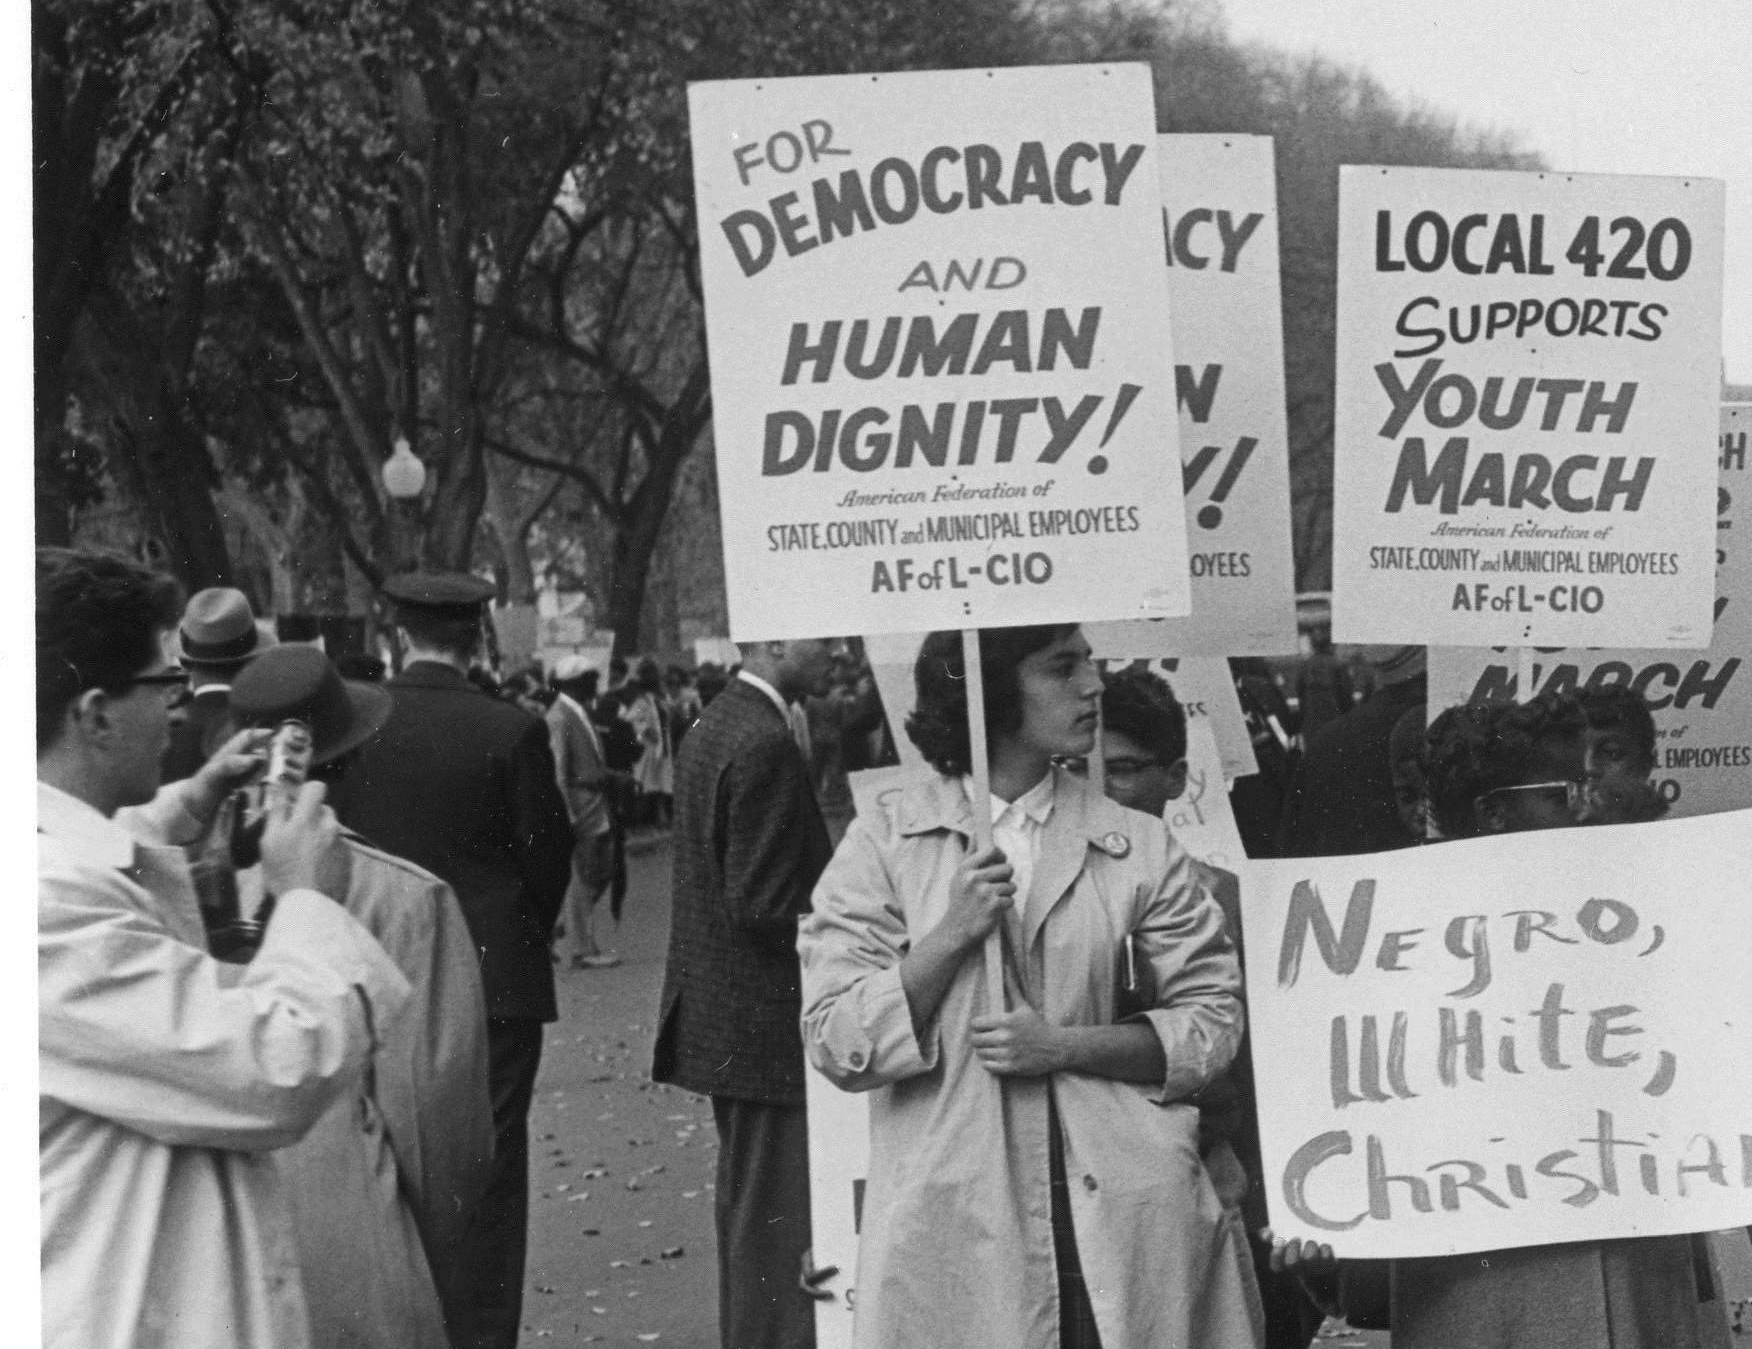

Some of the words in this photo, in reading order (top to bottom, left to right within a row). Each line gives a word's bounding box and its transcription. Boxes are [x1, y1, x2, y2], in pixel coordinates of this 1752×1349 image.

[732, 119, 851, 186] FOR
[721, 141, 1145, 277] DEMOCRACY
[899, 256, 1026, 292] AND
[1376, 210, 1554, 275] LOCAL
[1566, 217, 1692, 281] 420
[781, 307, 1102, 385] HUMAN
[761, 384, 1143, 477] DIGNITY!
[1374, 358, 1638, 439] YOUTH
[837, 486, 925, 508] American
[931, 482, 1027, 504] Federation
[1033, 479, 1055, 501] of
[1384, 437, 1655, 514] MARCH
[926, 511, 1024, 542] MUNICIPAL
[1030, 506, 1138, 536] EMPLOYEES
[1431, 523, 1505, 538] American
[1510, 524, 1589, 540] Federation
[1594, 526, 1613, 540] of
[1503, 550, 1584, 574] MUNICIPAL
[1588, 552, 1678, 575] EMPLOYEES
[1666, 747, 1750, 769] EMPLOYEES
